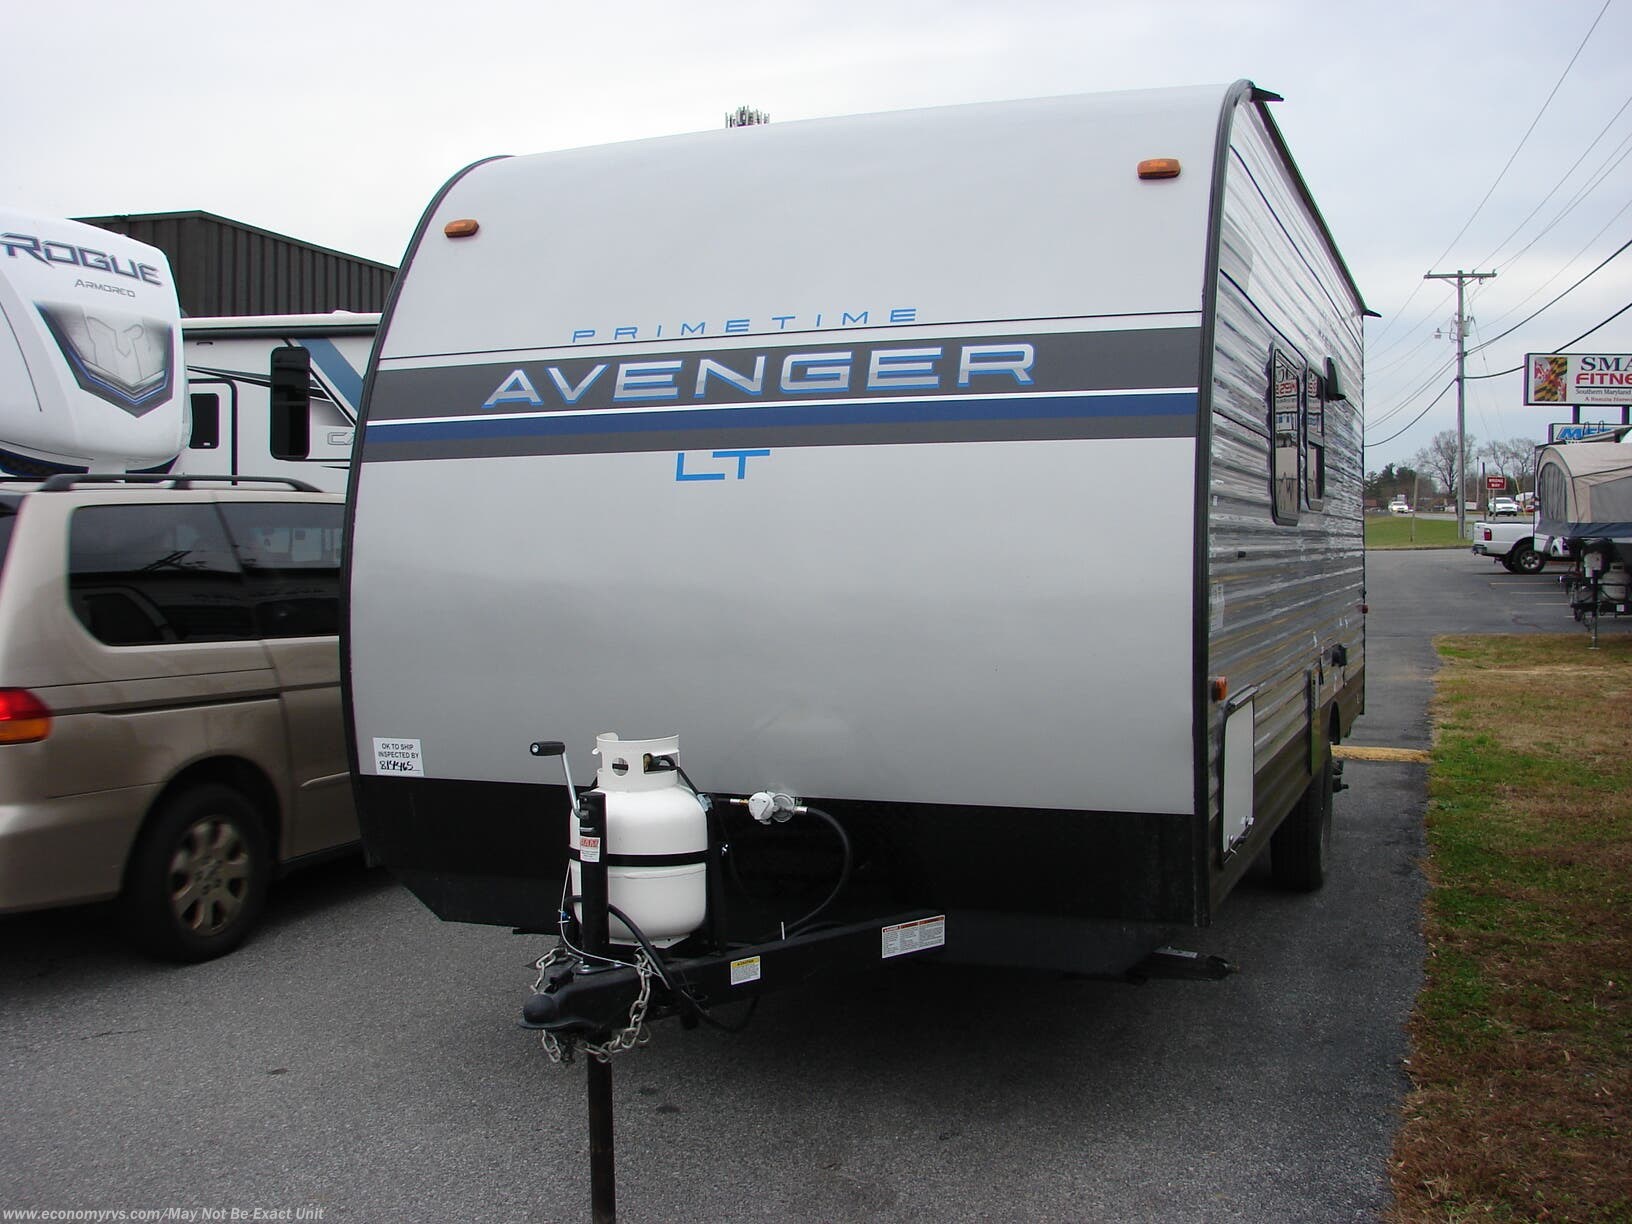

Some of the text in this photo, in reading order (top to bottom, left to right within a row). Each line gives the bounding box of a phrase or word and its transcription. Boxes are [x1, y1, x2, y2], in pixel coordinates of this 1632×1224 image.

[0, 232, 162, 286] ROGUE
[74, 279, 136, 298] ARMORED
[482, 343, 1036, 409] AVENGER
[1575, 388, 1632, 397] Southern Maryland
[675, 449, 770, 482] LT
[377, 751, 410, 759] INSPECTED
[400, 743, 414, 751] SHIP
